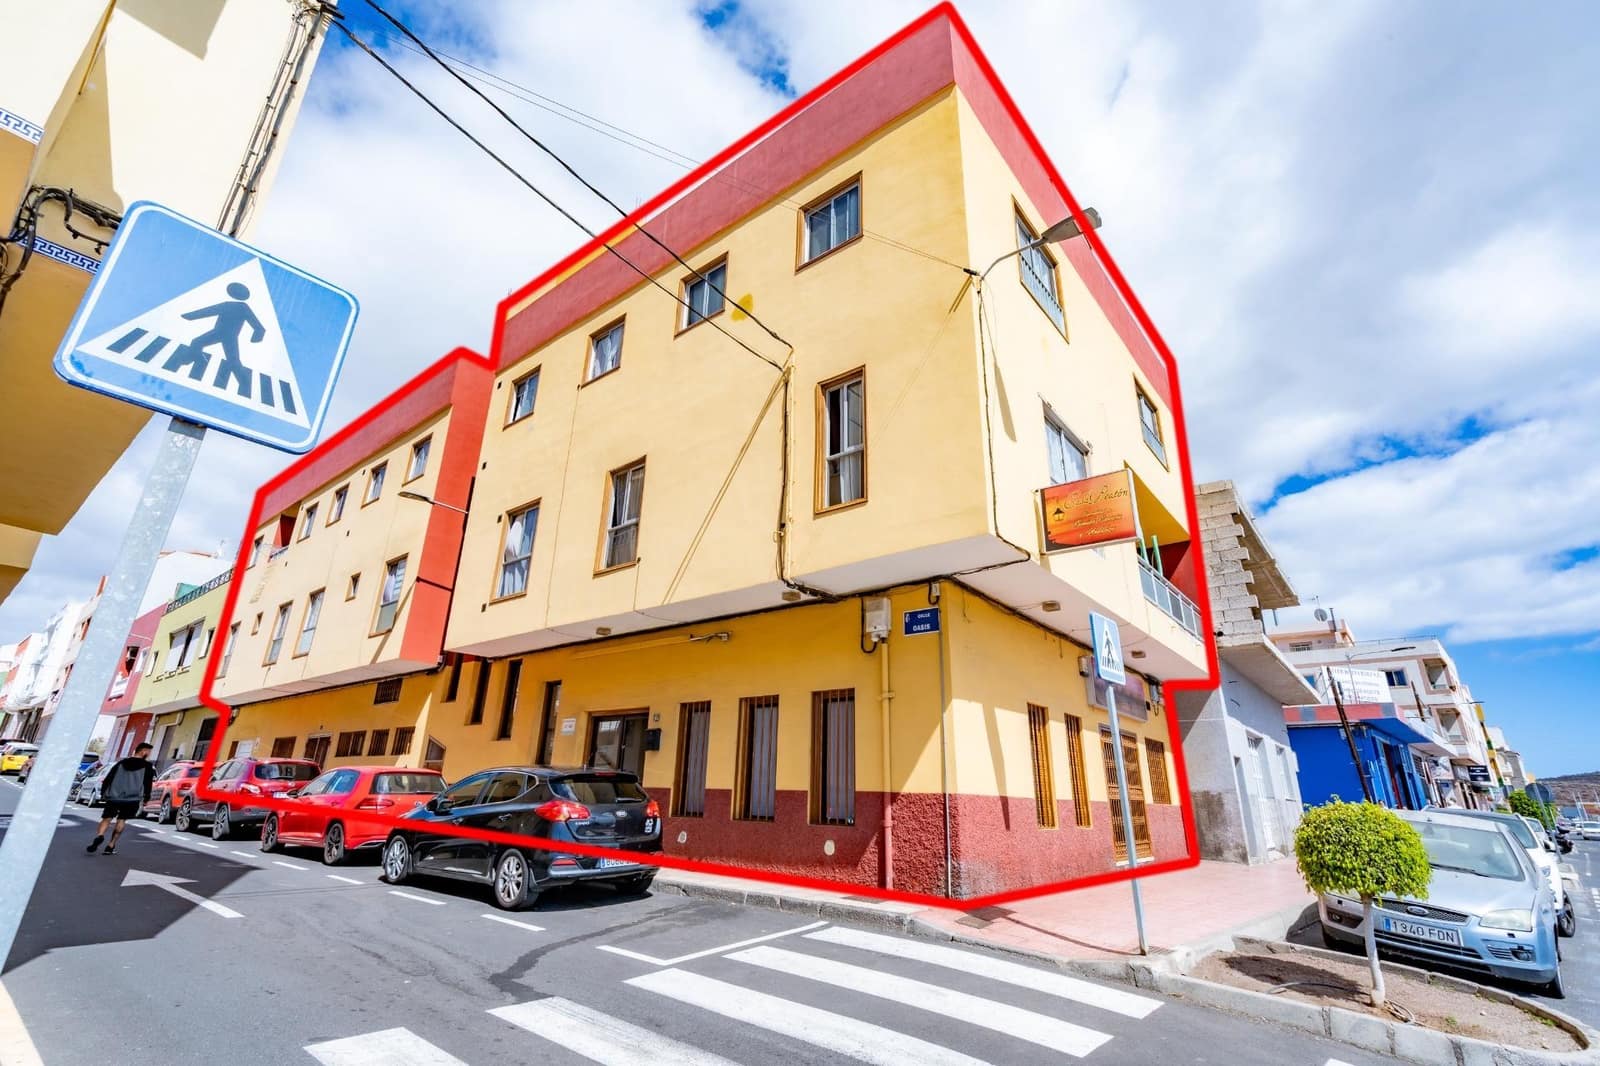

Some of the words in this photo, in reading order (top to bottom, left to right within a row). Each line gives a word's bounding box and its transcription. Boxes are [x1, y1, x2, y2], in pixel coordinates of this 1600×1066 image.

[912, 623, 931, 632] OASIS
[1392, 921, 1425, 936] 1340
[1428, 928, 1454, 943] FDN
